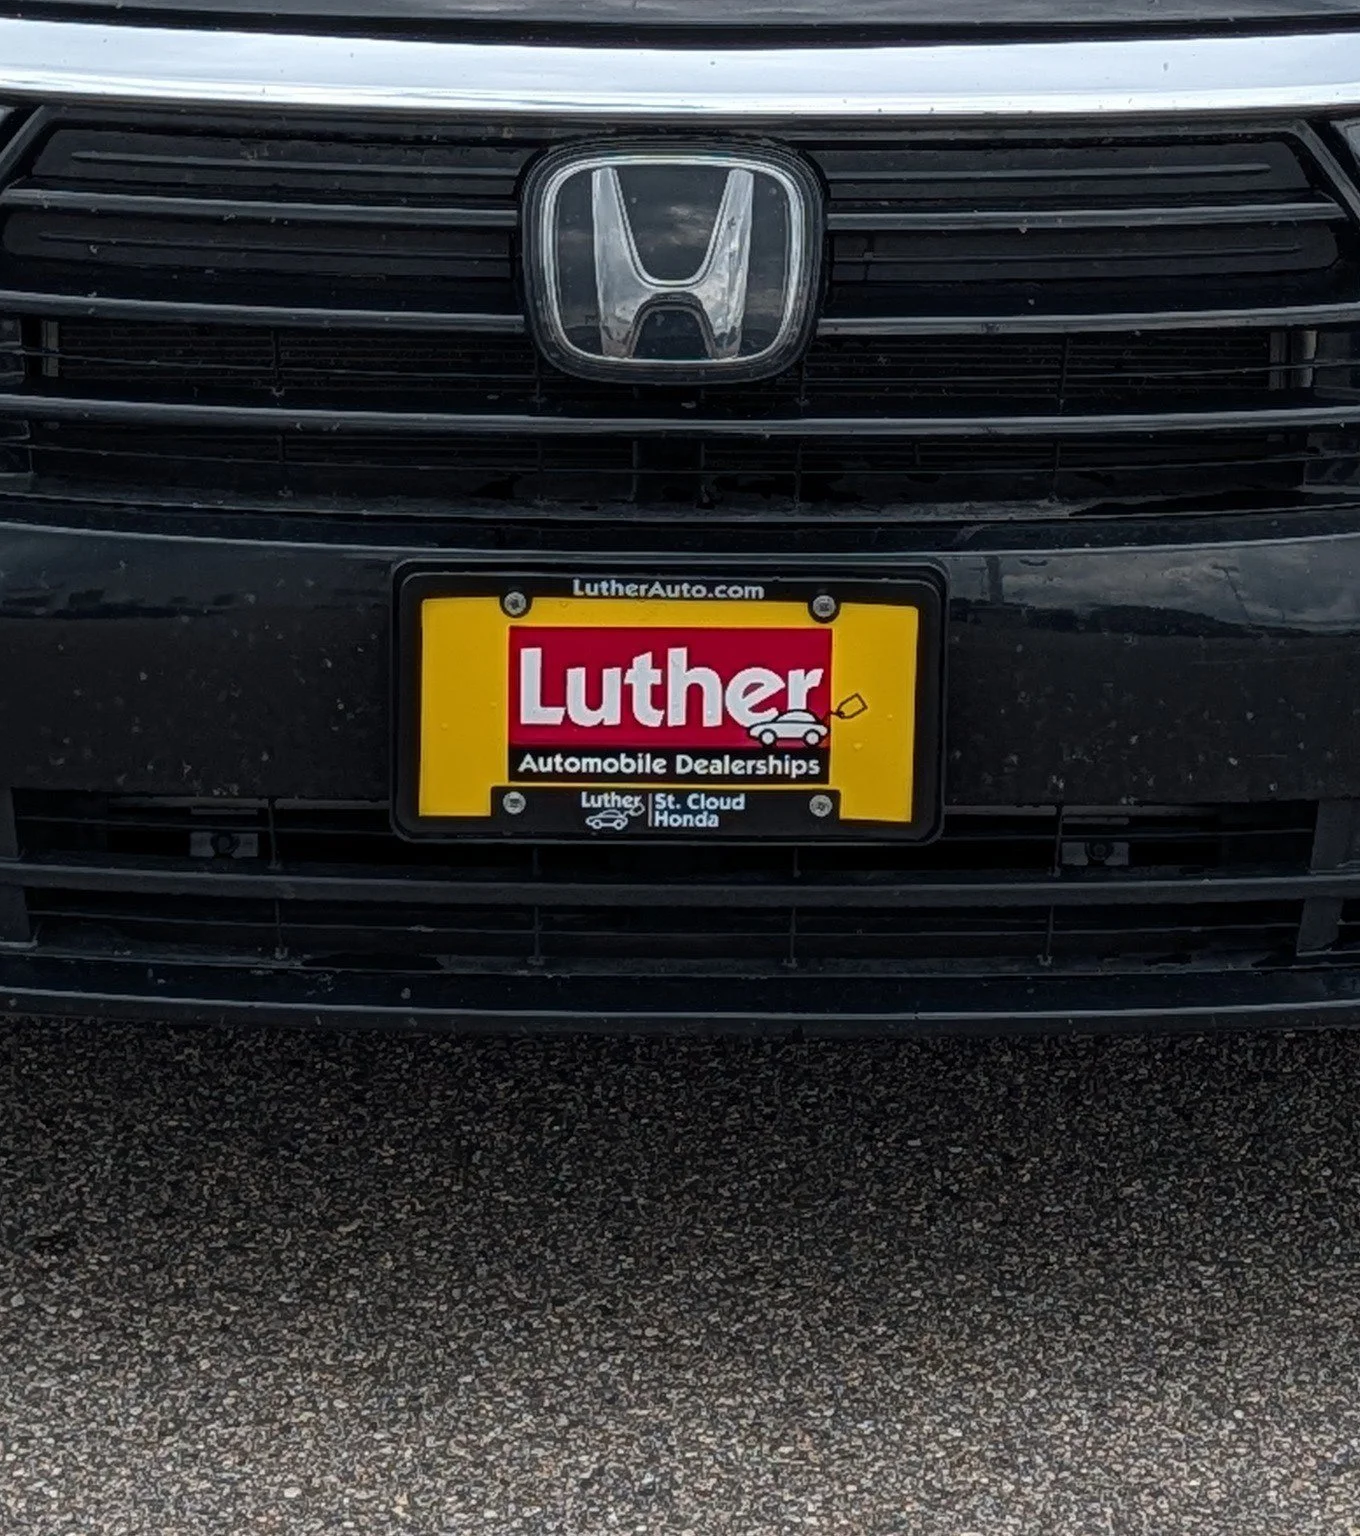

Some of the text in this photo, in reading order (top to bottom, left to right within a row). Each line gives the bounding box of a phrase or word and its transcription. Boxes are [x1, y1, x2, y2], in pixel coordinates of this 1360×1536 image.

[572, 578, 765, 600] LutherAuto.com
[518, 646, 824, 729] Luther
[517, 753, 821, 778] Automobile Dealerships
[580, 791, 642, 809] Luther
[654, 793, 746, 811] St. Cloud
[654, 811, 720, 828] Honda
